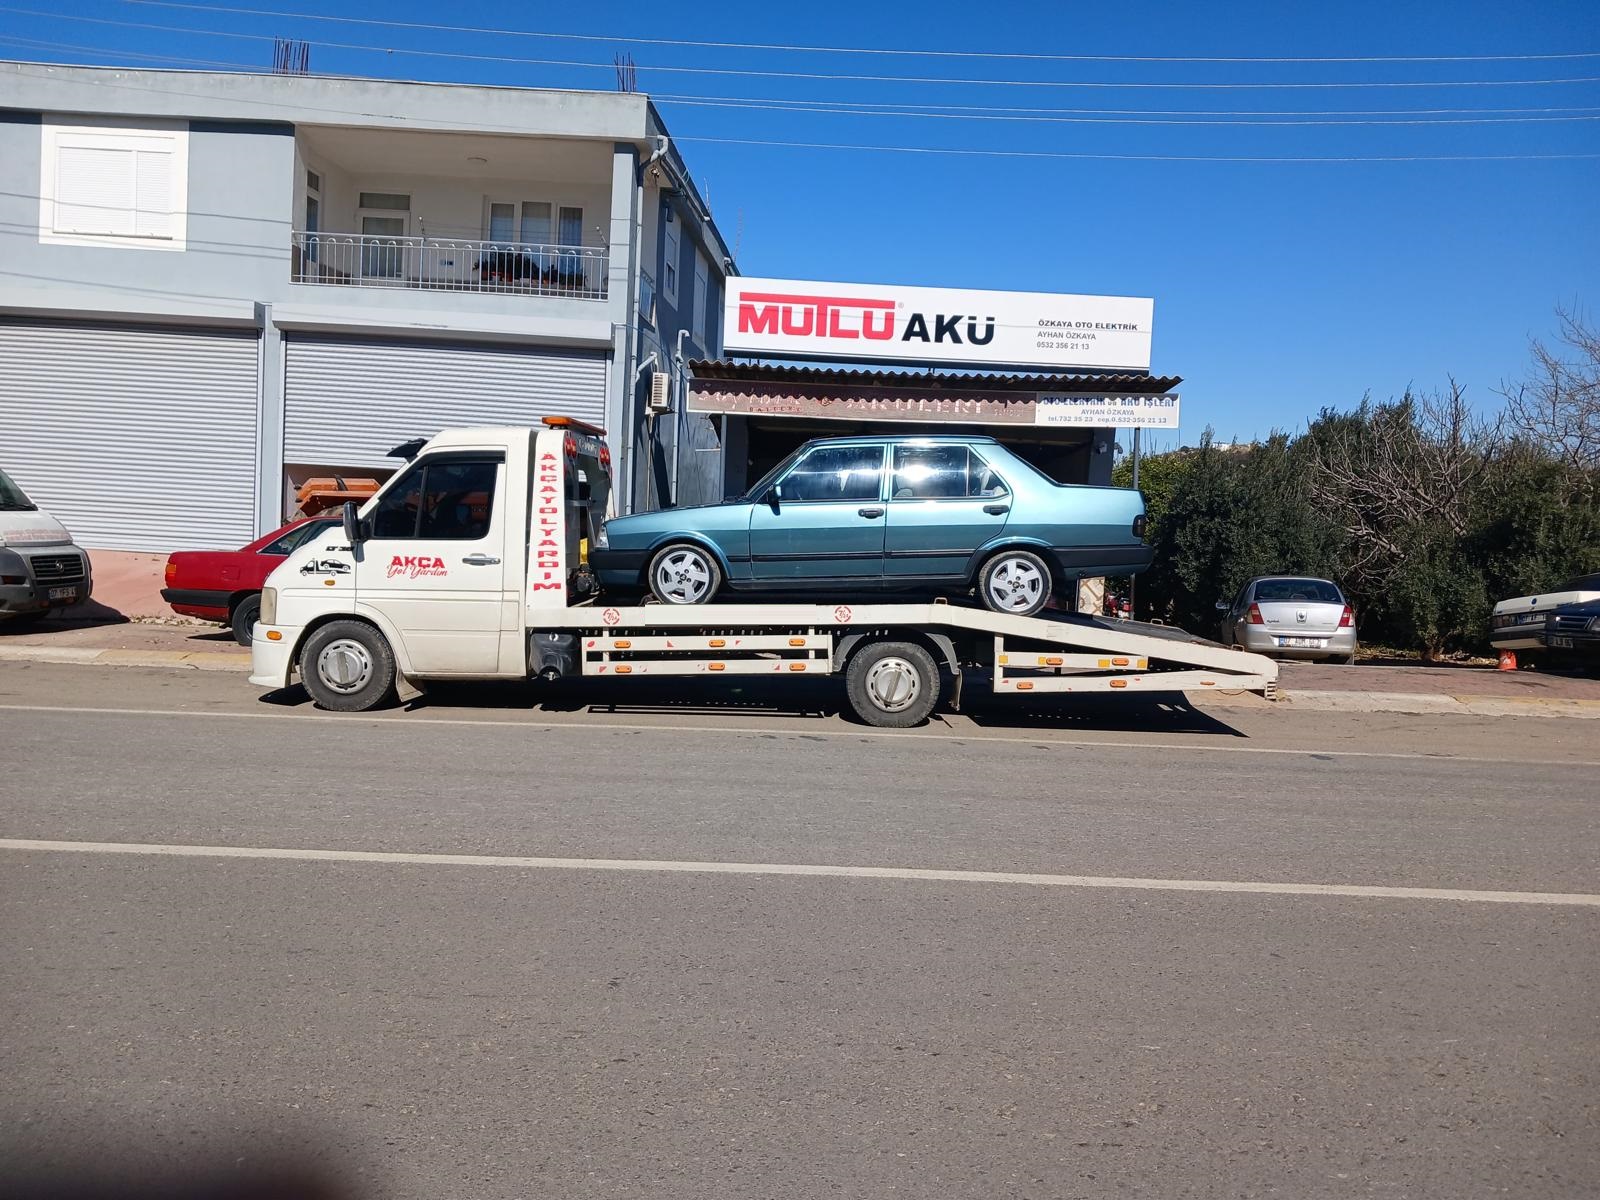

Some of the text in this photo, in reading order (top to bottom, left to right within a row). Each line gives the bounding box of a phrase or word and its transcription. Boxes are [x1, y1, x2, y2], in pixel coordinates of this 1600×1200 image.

[738, 292, 996, 345] MUTLU AKÜ
[1038, 319, 1138, 331] ÖZKAYA OTO ELEKTRİK
[1037, 331, 1096, 340] AYHAN ÖZKAYA
[1036, 341, 1054, 349] 0532
[1106, 408, 1135, 416] ÖZKAYA
[391, 555, 446, 569] AKÇA
[387, 563, 408, 579] Yol
